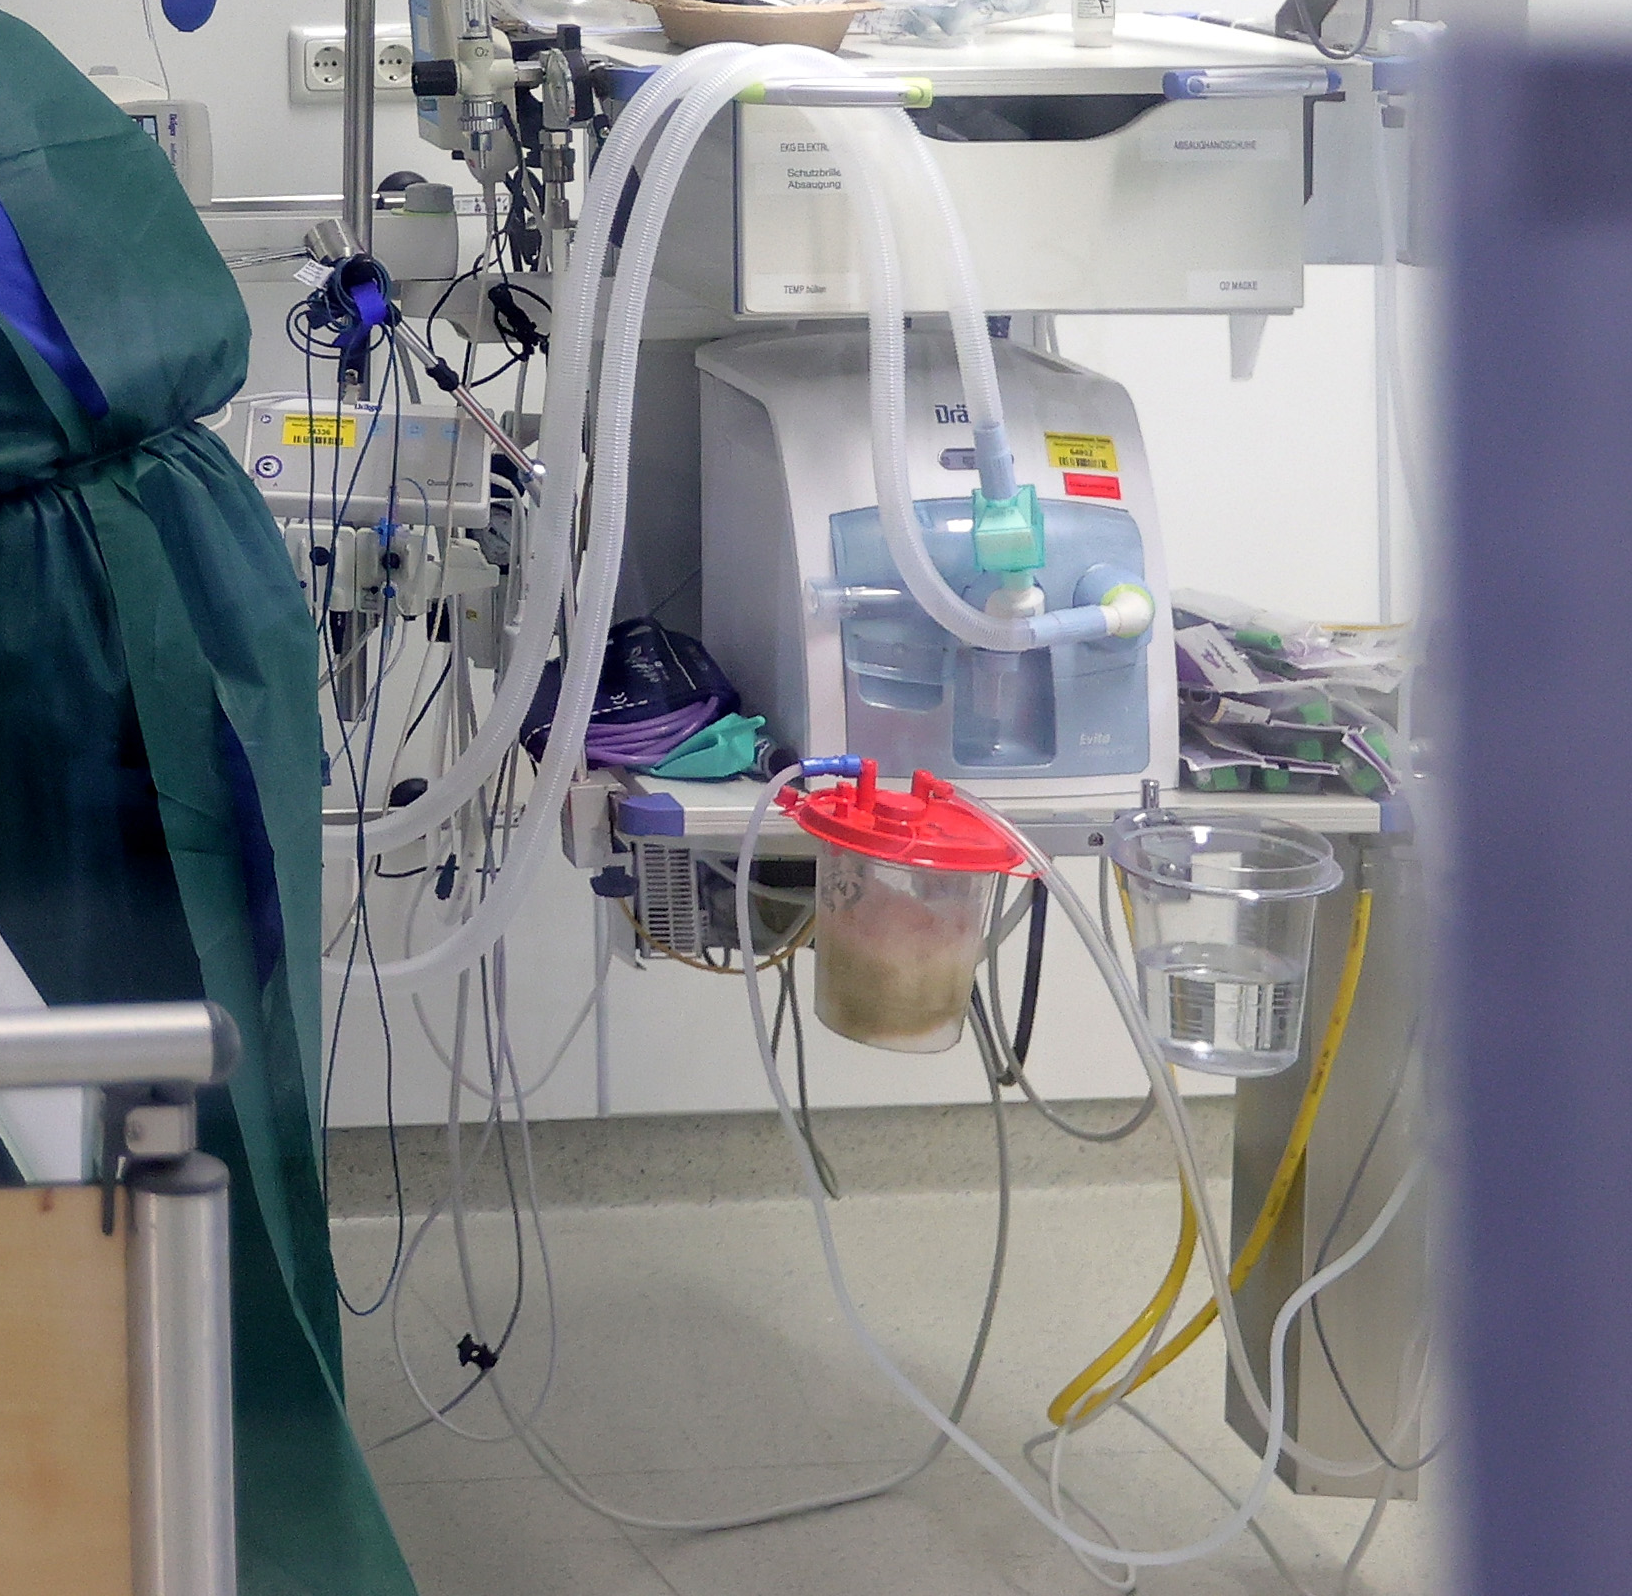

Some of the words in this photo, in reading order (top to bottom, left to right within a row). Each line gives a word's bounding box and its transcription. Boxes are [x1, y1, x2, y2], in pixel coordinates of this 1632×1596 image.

[780, 142, 797, 152] EKG
[788, 180, 842, 190] Absaugung
[935, 404, 972, 424] Drä
